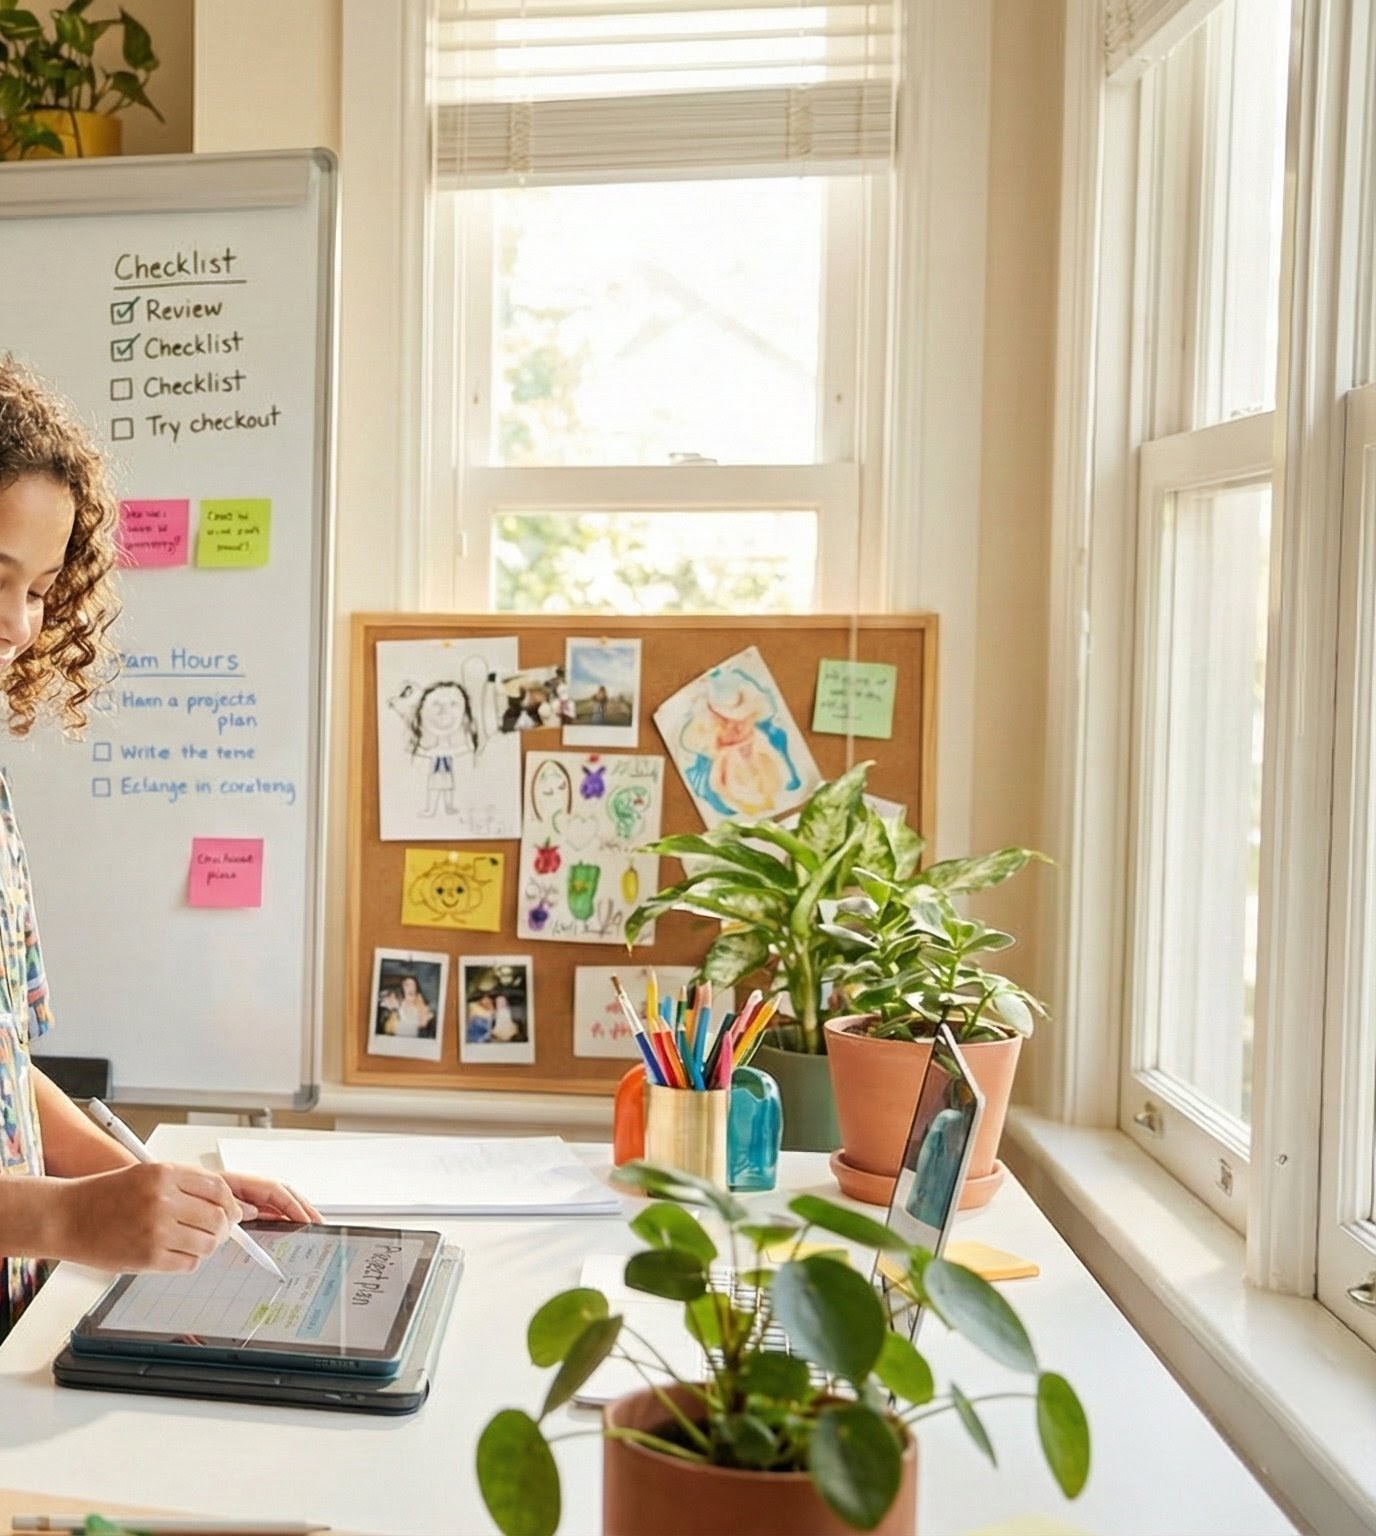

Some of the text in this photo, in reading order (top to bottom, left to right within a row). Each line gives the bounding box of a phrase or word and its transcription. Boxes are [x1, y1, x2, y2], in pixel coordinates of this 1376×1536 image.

[114, 247, 236, 280] Checklist
[146, 299, 223, 321] Review
[143, 330, 244, 359] Checklist
[143, 369, 247, 398] Checklist
[145, 404, 282, 443] Try checkout
[171, 648, 239, 670] Hours
[167, 696, 179, 708] a
[217, 712, 258, 736] plan
[120, 744, 171, 760] Write
[181, 743, 209, 760] the
[195, 778, 212, 794] in
